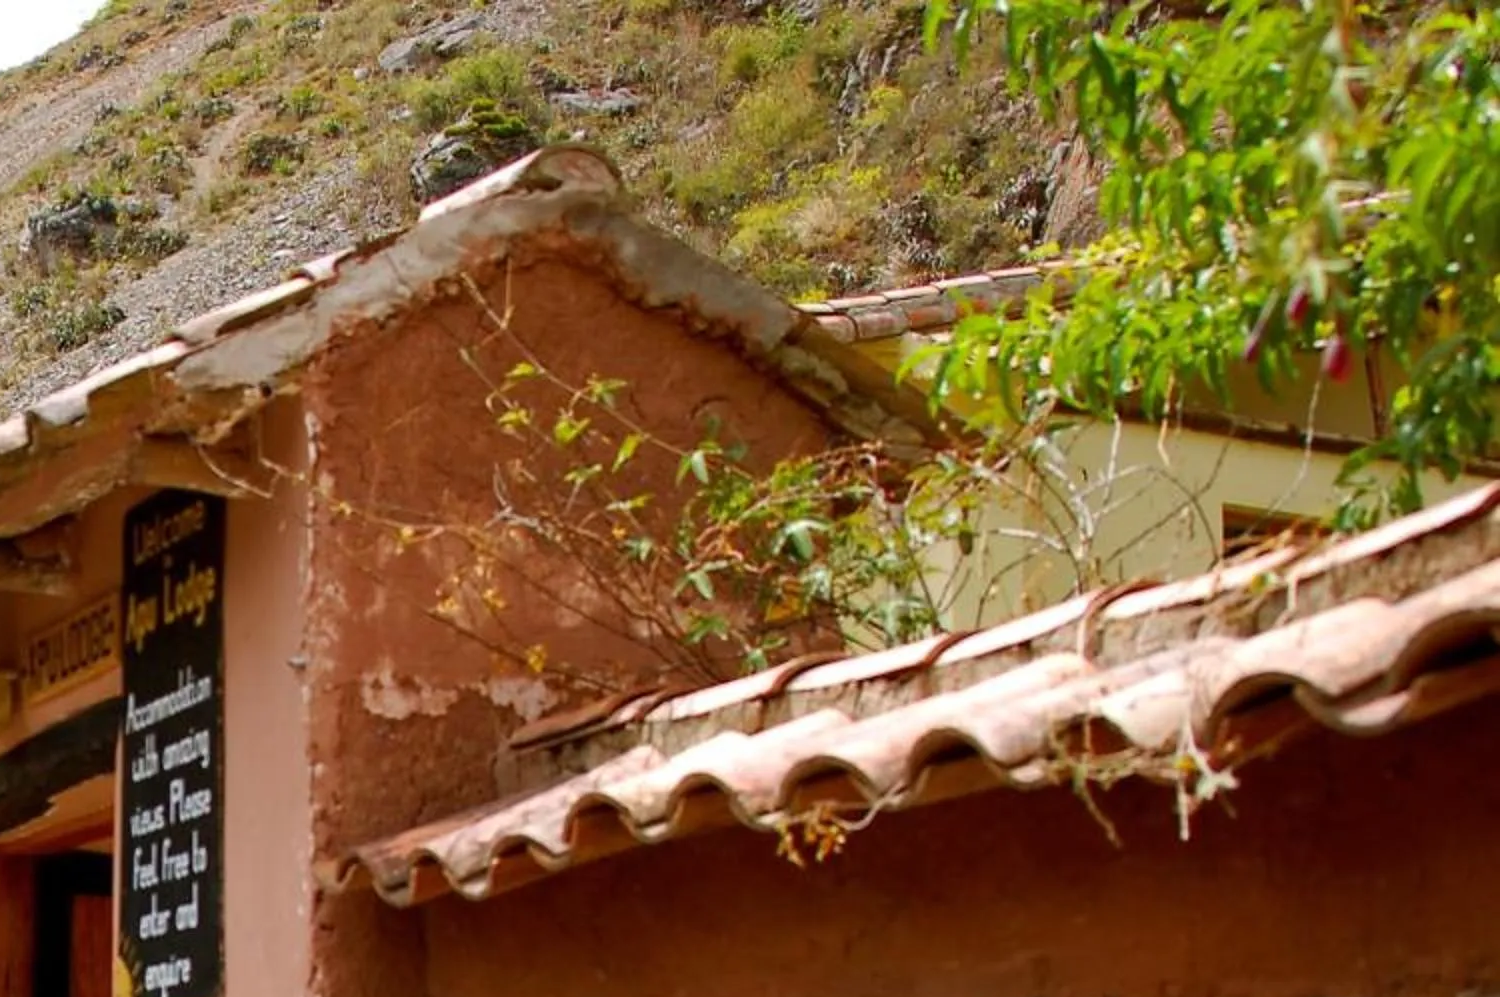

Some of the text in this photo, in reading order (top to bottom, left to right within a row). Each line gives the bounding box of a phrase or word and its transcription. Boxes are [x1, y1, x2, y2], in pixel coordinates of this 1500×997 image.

[163, 559, 217, 628] Lodge
[131, 728, 211, 783] with amazing
[169, 777, 213, 825] Please
[192, 829, 208, 874] to
[140, 881, 199, 940] enter and
